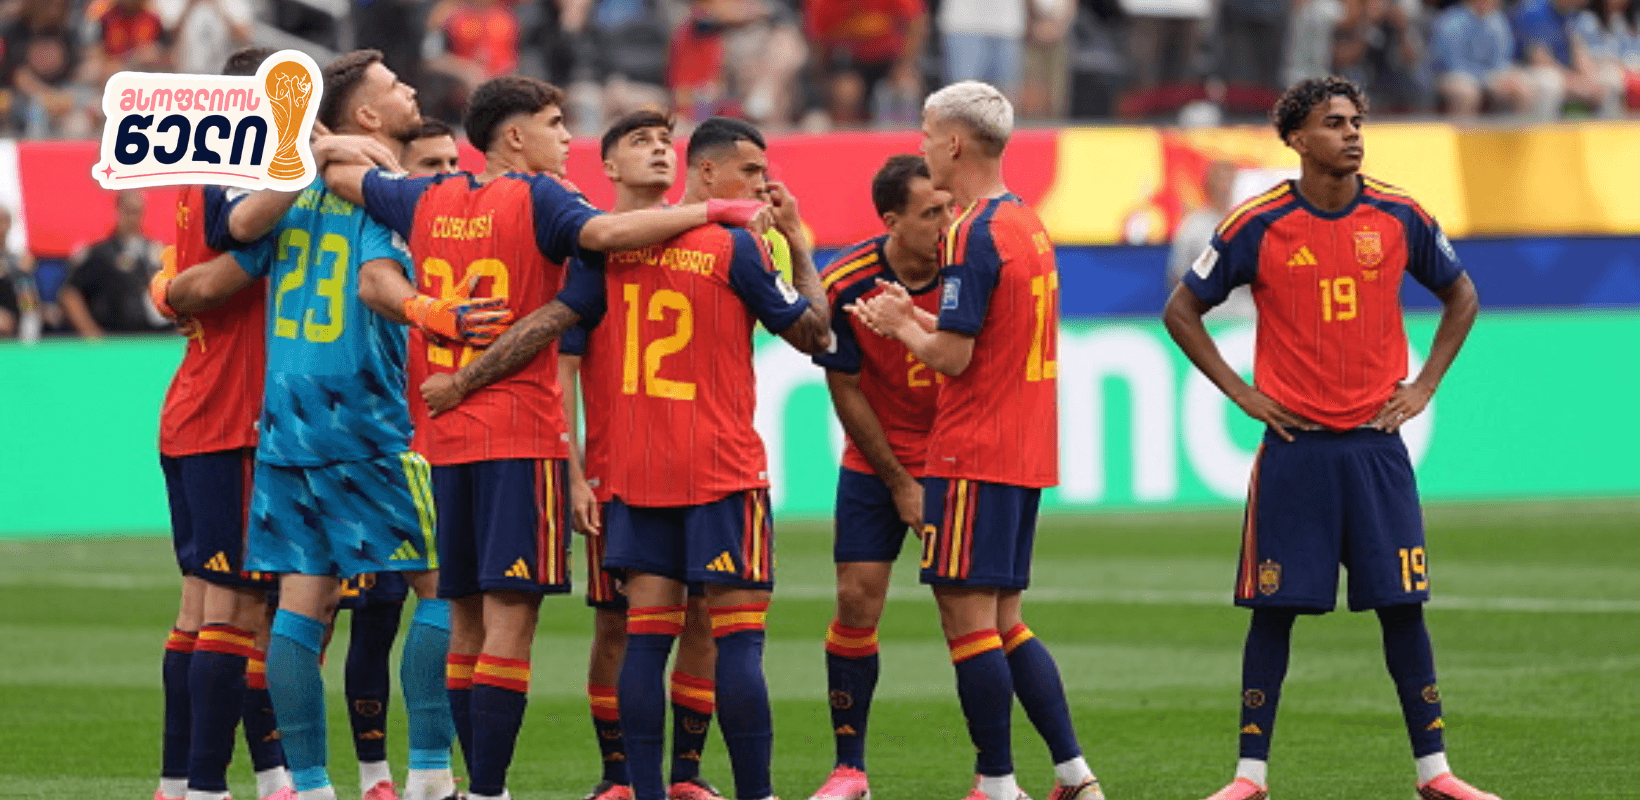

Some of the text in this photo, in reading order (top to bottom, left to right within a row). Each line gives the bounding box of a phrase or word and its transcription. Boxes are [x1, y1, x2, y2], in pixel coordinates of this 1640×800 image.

[274, 228, 350, 342] 23
[1319, 276, 1358, 322] 19
[622, 283, 698, 401] 12
[1398, 546, 1430, 593] 19
